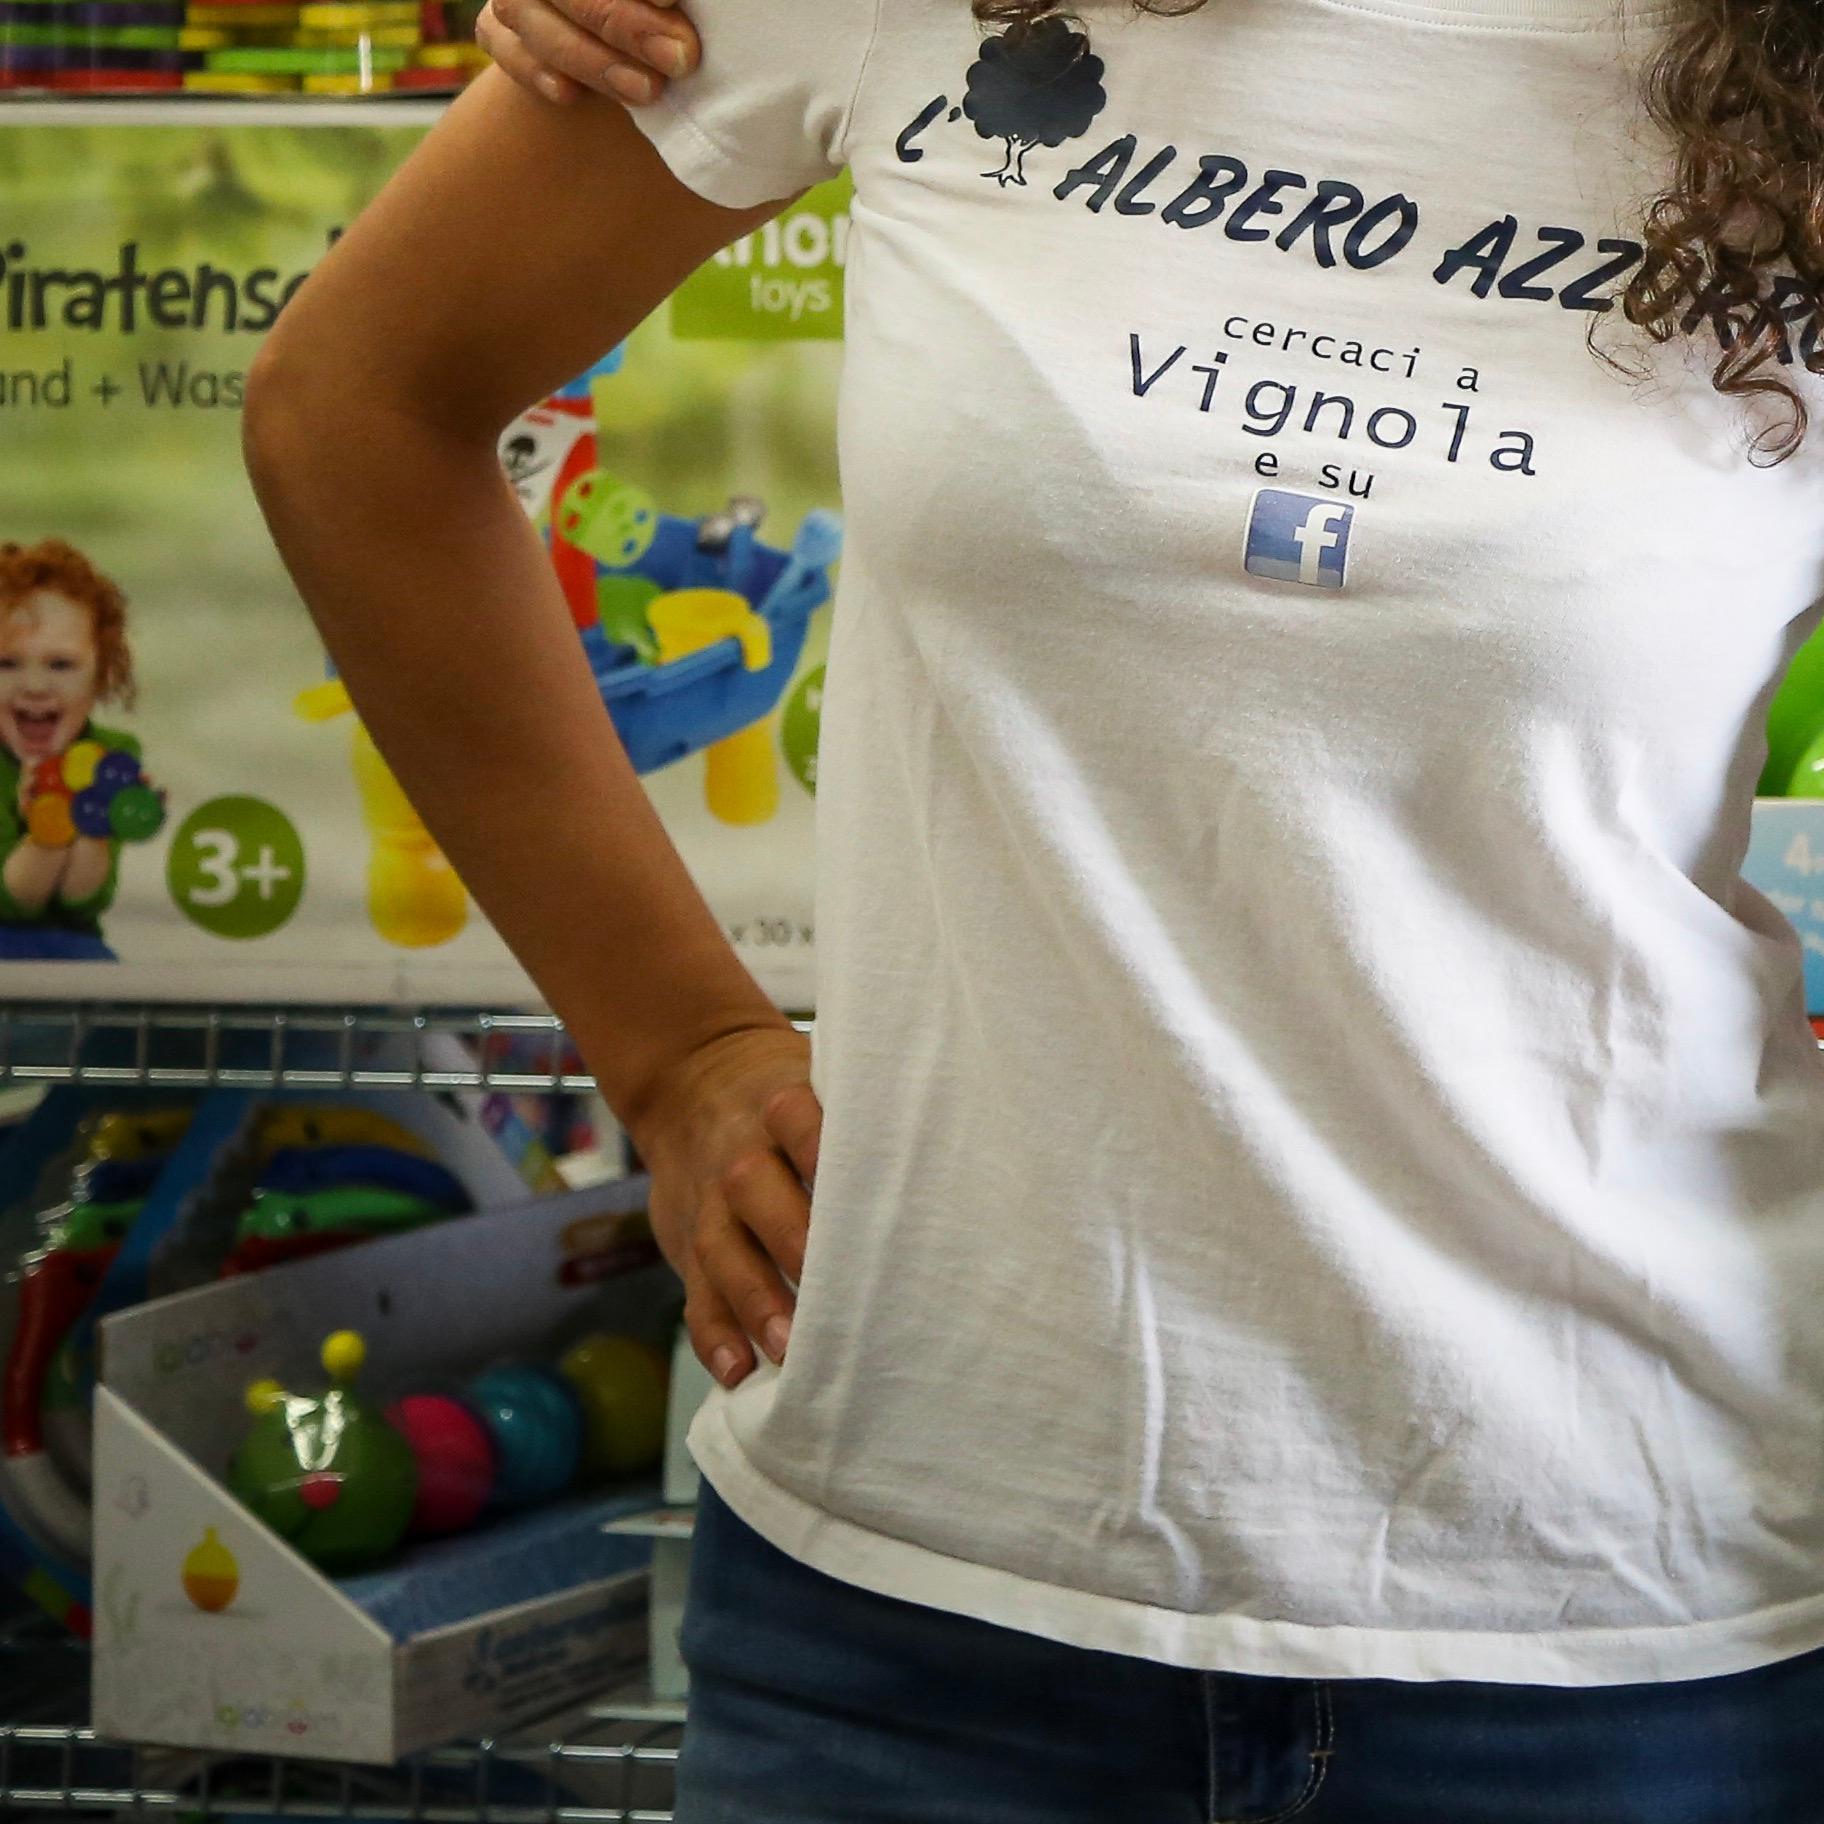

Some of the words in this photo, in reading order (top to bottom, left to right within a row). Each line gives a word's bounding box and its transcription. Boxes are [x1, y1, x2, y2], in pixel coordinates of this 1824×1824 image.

[1052, 133, 1419, 271] ALBERO
[0, 227, 344, 333] iratens
[750, 274, 833, 323] toys
[138, 360, 243, 409] Was
[1223, 315, 1421, 379] cercaci
[1455, 366, 1480, 394] a
[1128, 332, 1537, 477] Vignola
[1254, 451, 1279, 478] e
[1317, 462, 1375, 500] su
[189, 827, 292, 908] 3+
